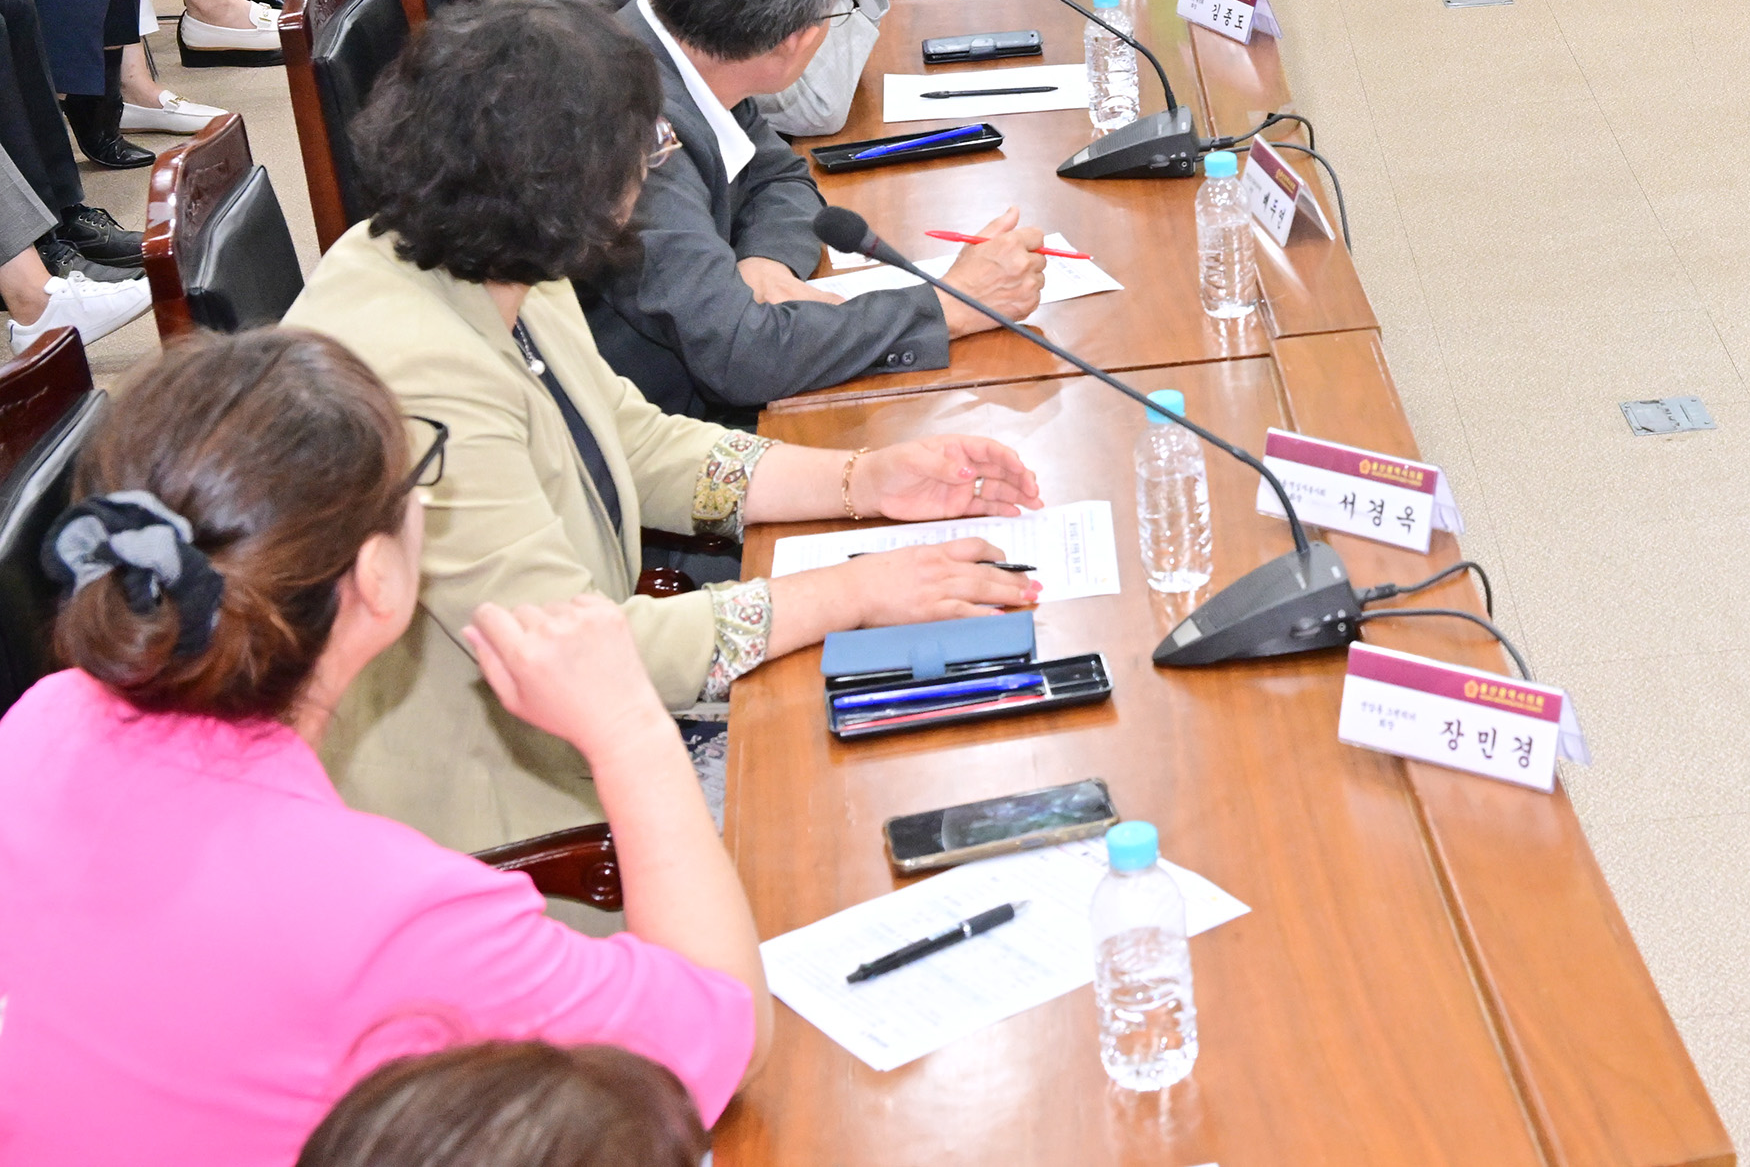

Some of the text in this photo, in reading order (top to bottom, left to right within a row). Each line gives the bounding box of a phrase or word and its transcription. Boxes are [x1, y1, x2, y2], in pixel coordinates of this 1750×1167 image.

[1211, 3, 1245, 30] 김종도
[1338, 491, 1416, 535] 서경옥
[1440, 719, 1534, 769] 장민경
